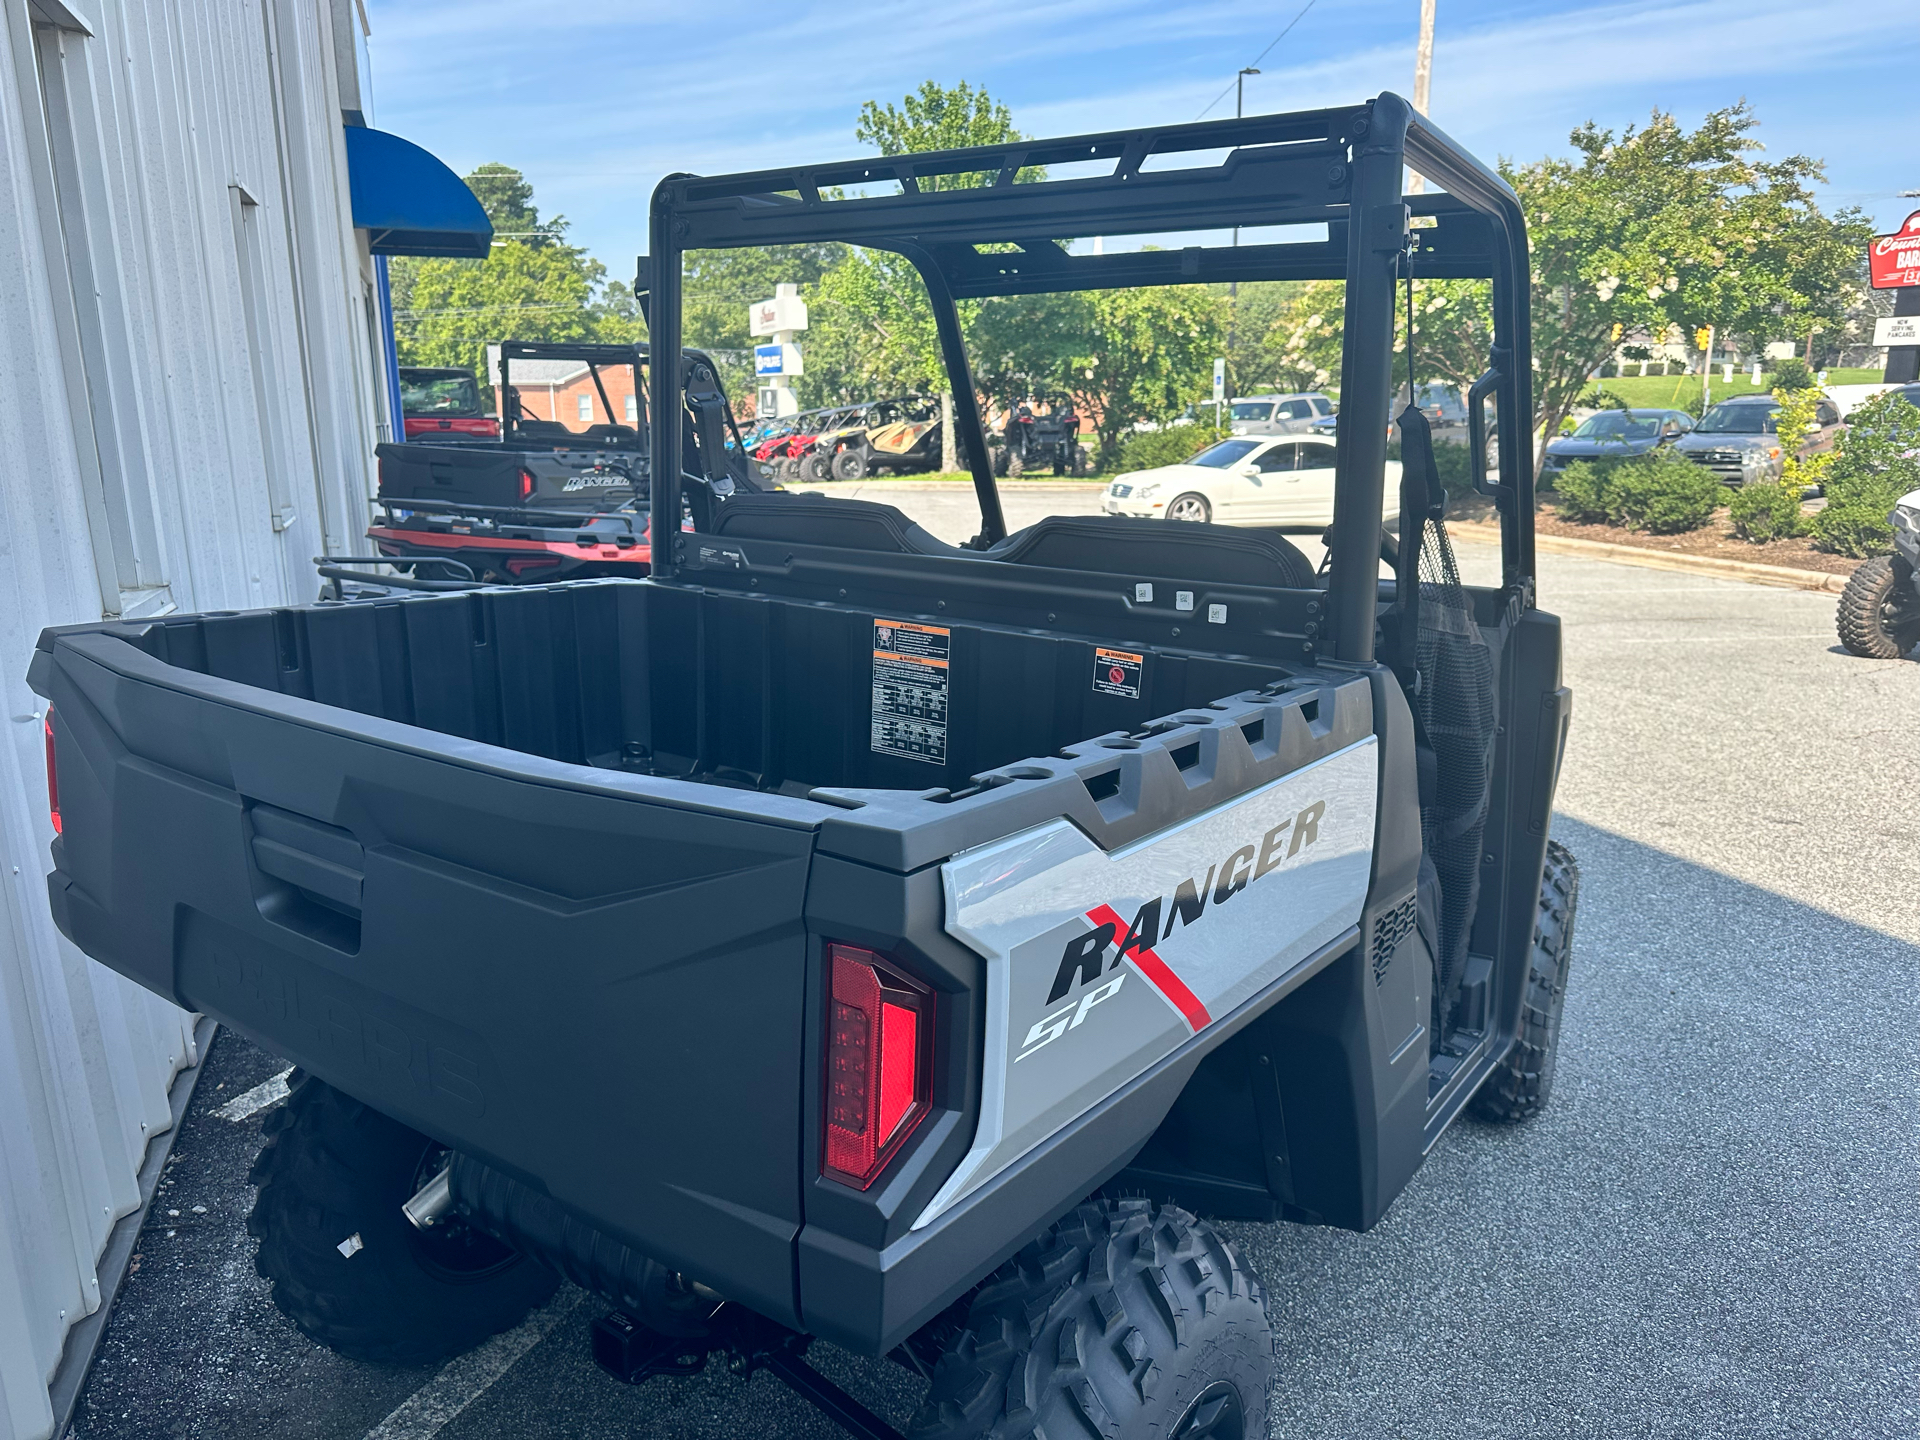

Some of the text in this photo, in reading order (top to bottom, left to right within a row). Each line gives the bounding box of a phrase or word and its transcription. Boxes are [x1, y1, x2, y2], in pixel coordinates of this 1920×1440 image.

[1896, 250, 1920, 269] BAR
[904, 623, 923, 632] WARNING
[1110, 652, 1134, 660] WARNING
[1045, 800, 1326, 1006] RANGER
[1014, 973, 1127, 1064] SP
